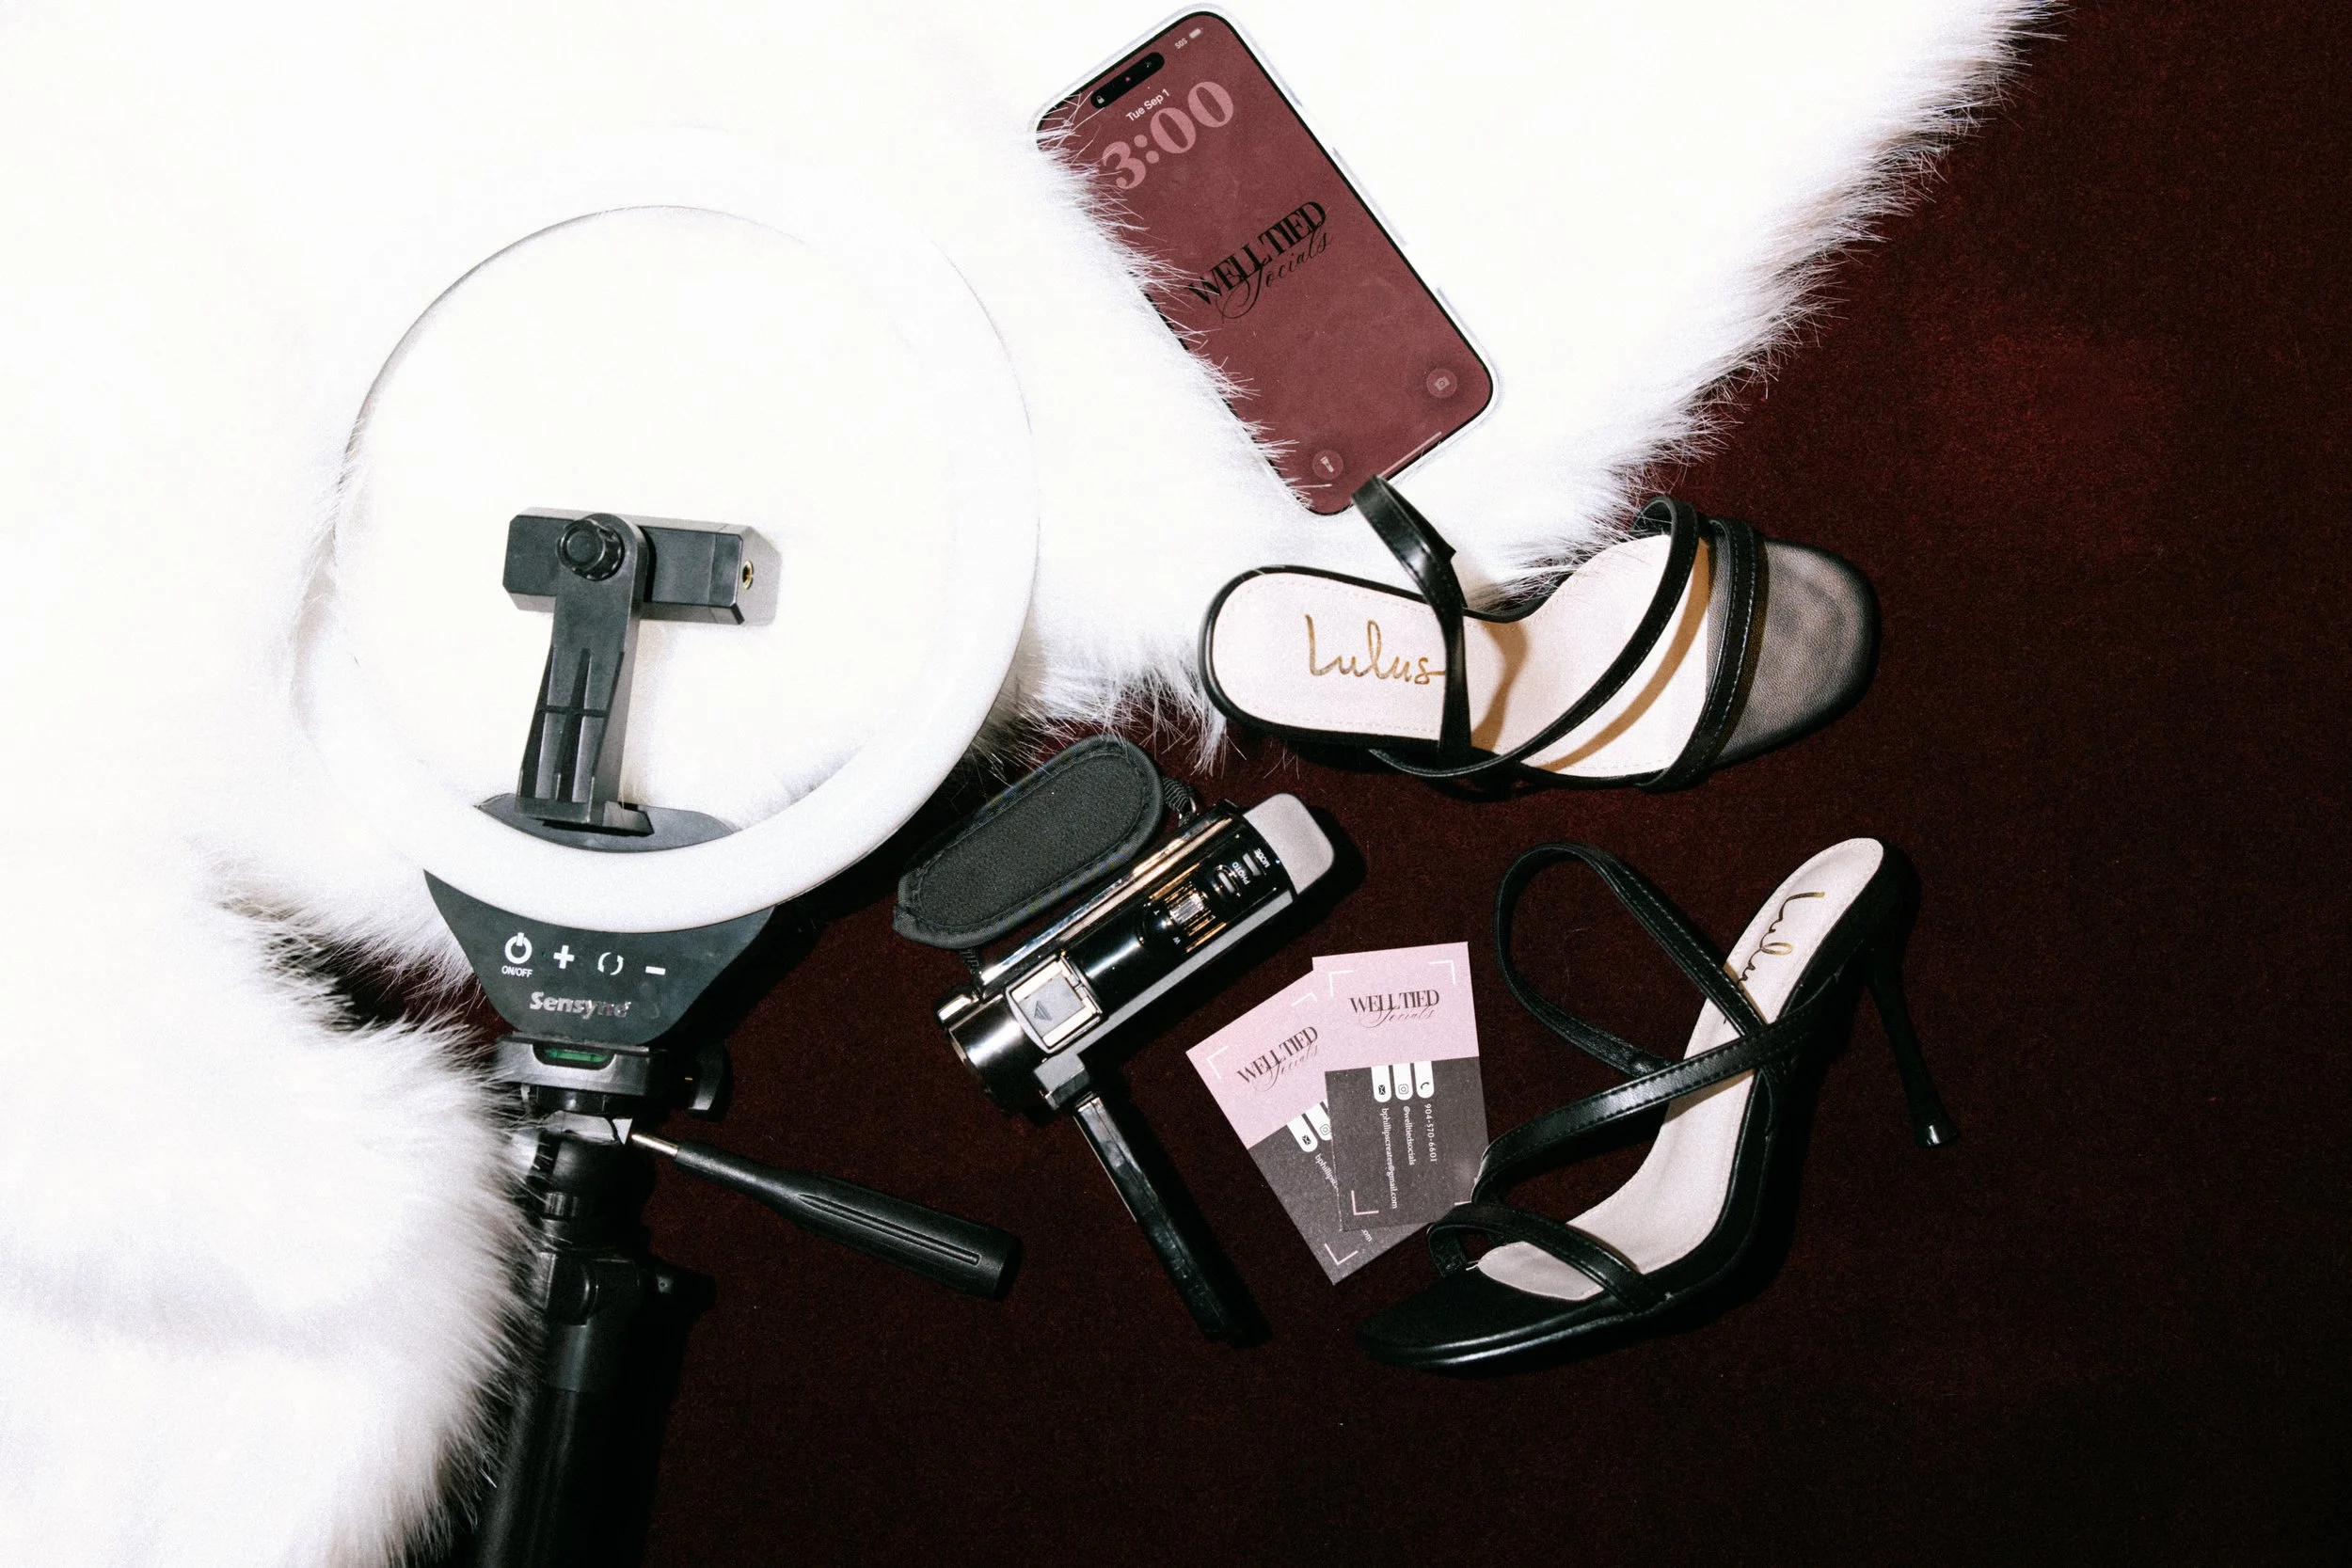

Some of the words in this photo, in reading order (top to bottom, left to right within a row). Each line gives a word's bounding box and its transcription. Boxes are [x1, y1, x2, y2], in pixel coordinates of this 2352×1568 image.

[1174, 37, 1189, 50] SOS
[1125, 105, 1146, 121] Tue
[1143, 94, 1165, 111] Sep
[1161, 88, 1170, 98] 1
[1102, 81, 1234, 190] 3:00
[1184, 243, 1272, 305] WELL
[1257, 201, 1327, 256] TIED
[1305, 614, 1446, 685] Lulus
[1232, 861, 1251, 885] PHOTO
[1253, 847, 1271, 868] MODE
[1737, 891, 1826, 985] Lulu
[501, 965, 533, 978] ON/OFF
[1349, 993, 1400, 1013] WELL
[1399, 989, 1439, 1009] TIED
[1236, 1049, 1286, 1083] WELL
[1279, 1026, 1318, 1056] TIED
[1380, 1108, 1398, 1209] bphillipscreates@gmail.com
[1403, 1105, 1417, 1165] @welltiedsocials
[1424, 1103, 1438, 1163] 904-570-6601
[1314, 1153, 1338, 1189] bphillipsc
